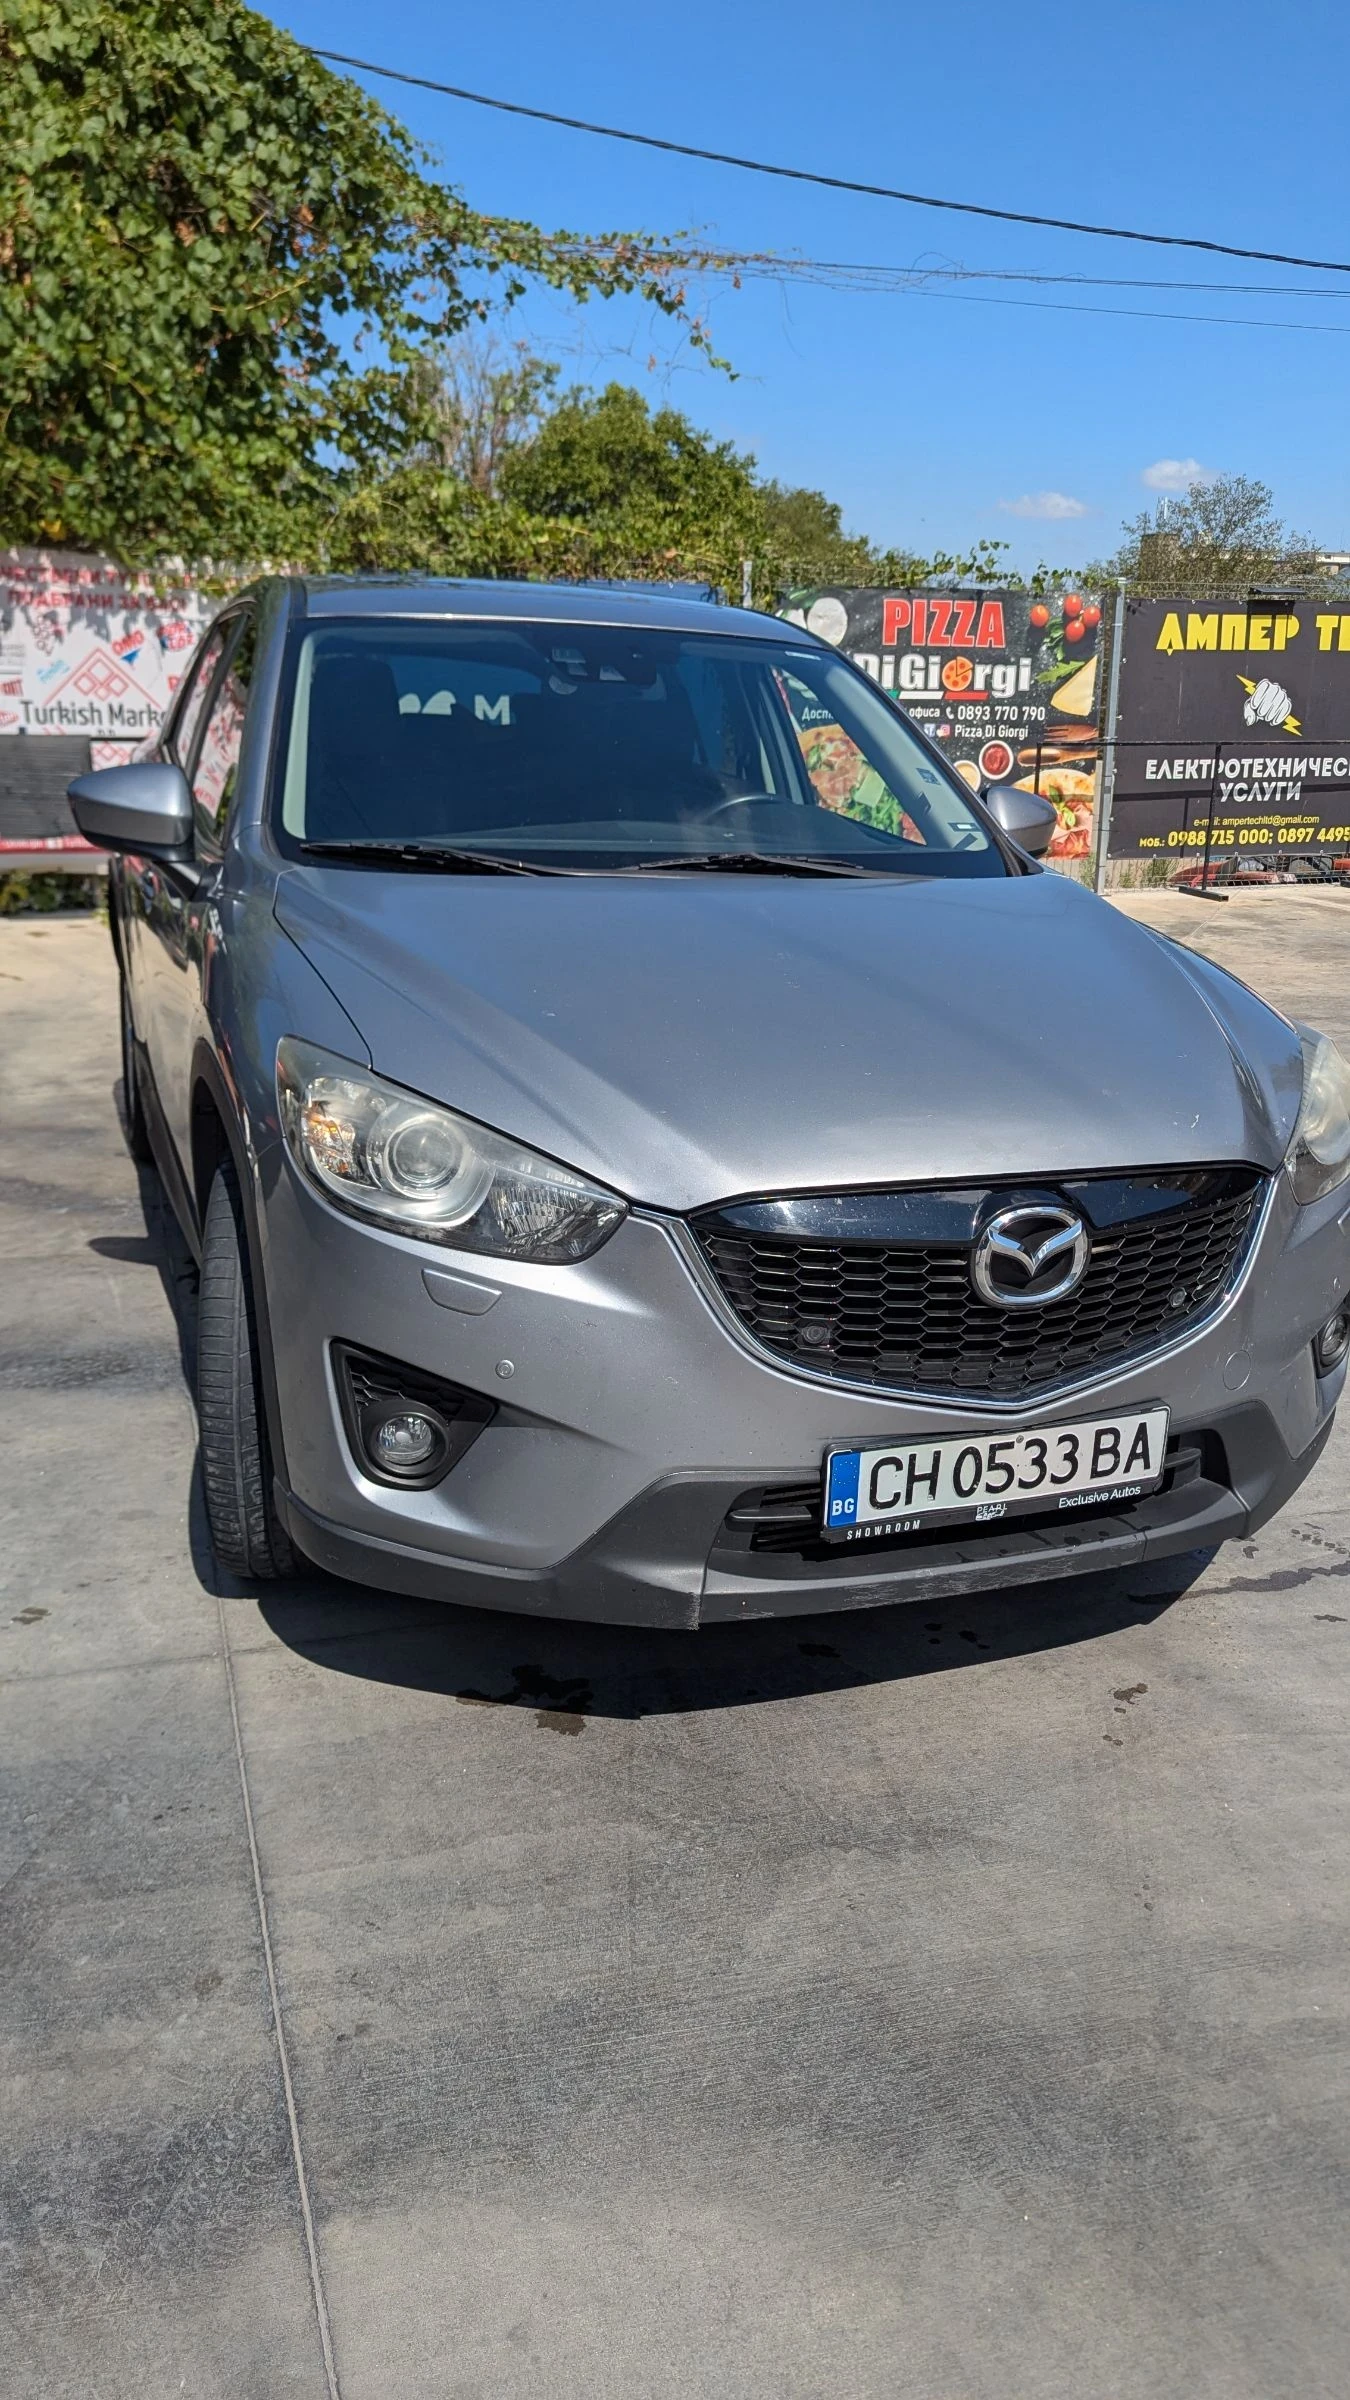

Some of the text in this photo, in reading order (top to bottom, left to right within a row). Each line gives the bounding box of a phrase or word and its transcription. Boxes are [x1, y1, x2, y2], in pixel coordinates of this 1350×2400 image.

[881, 597, 1007, 649] PIZZA
[1155, 612, 1301, 656] АМПЕР
[20, 699, 103, 727] Turkish
[908, 705, 941, 720] офиса
[957, 705, 991, 721] 0893
[994, 706, 1019, 721] 770
[1022, 706, 1046, 721] 790
[954, 724, 1029, 741] Pizza Di Giorgi
[1145, 757, 1350, 780] ЕЛЕКТРОТЕХНИЧЕС
[1219, 781, 1302, 803] УСЛУГИ
[1193, 815, 1320, 828] e-mil: ampertechltd@gmail.com
[1167, 830, 1207, 847] 0988
[1210, 830, 1235, 846] 715
[1238, 829, 1274, 845] 000;
[1277, 828, 1315, 844] 0897
[868, 1421, 1153, 1511] CH 0533 BA
[831, 1497, 856, 1517] BG
[1058, 1485, 1142, 1510] Exclusive Autos
[846, 1519, 922, 1541] SHOWROOM
